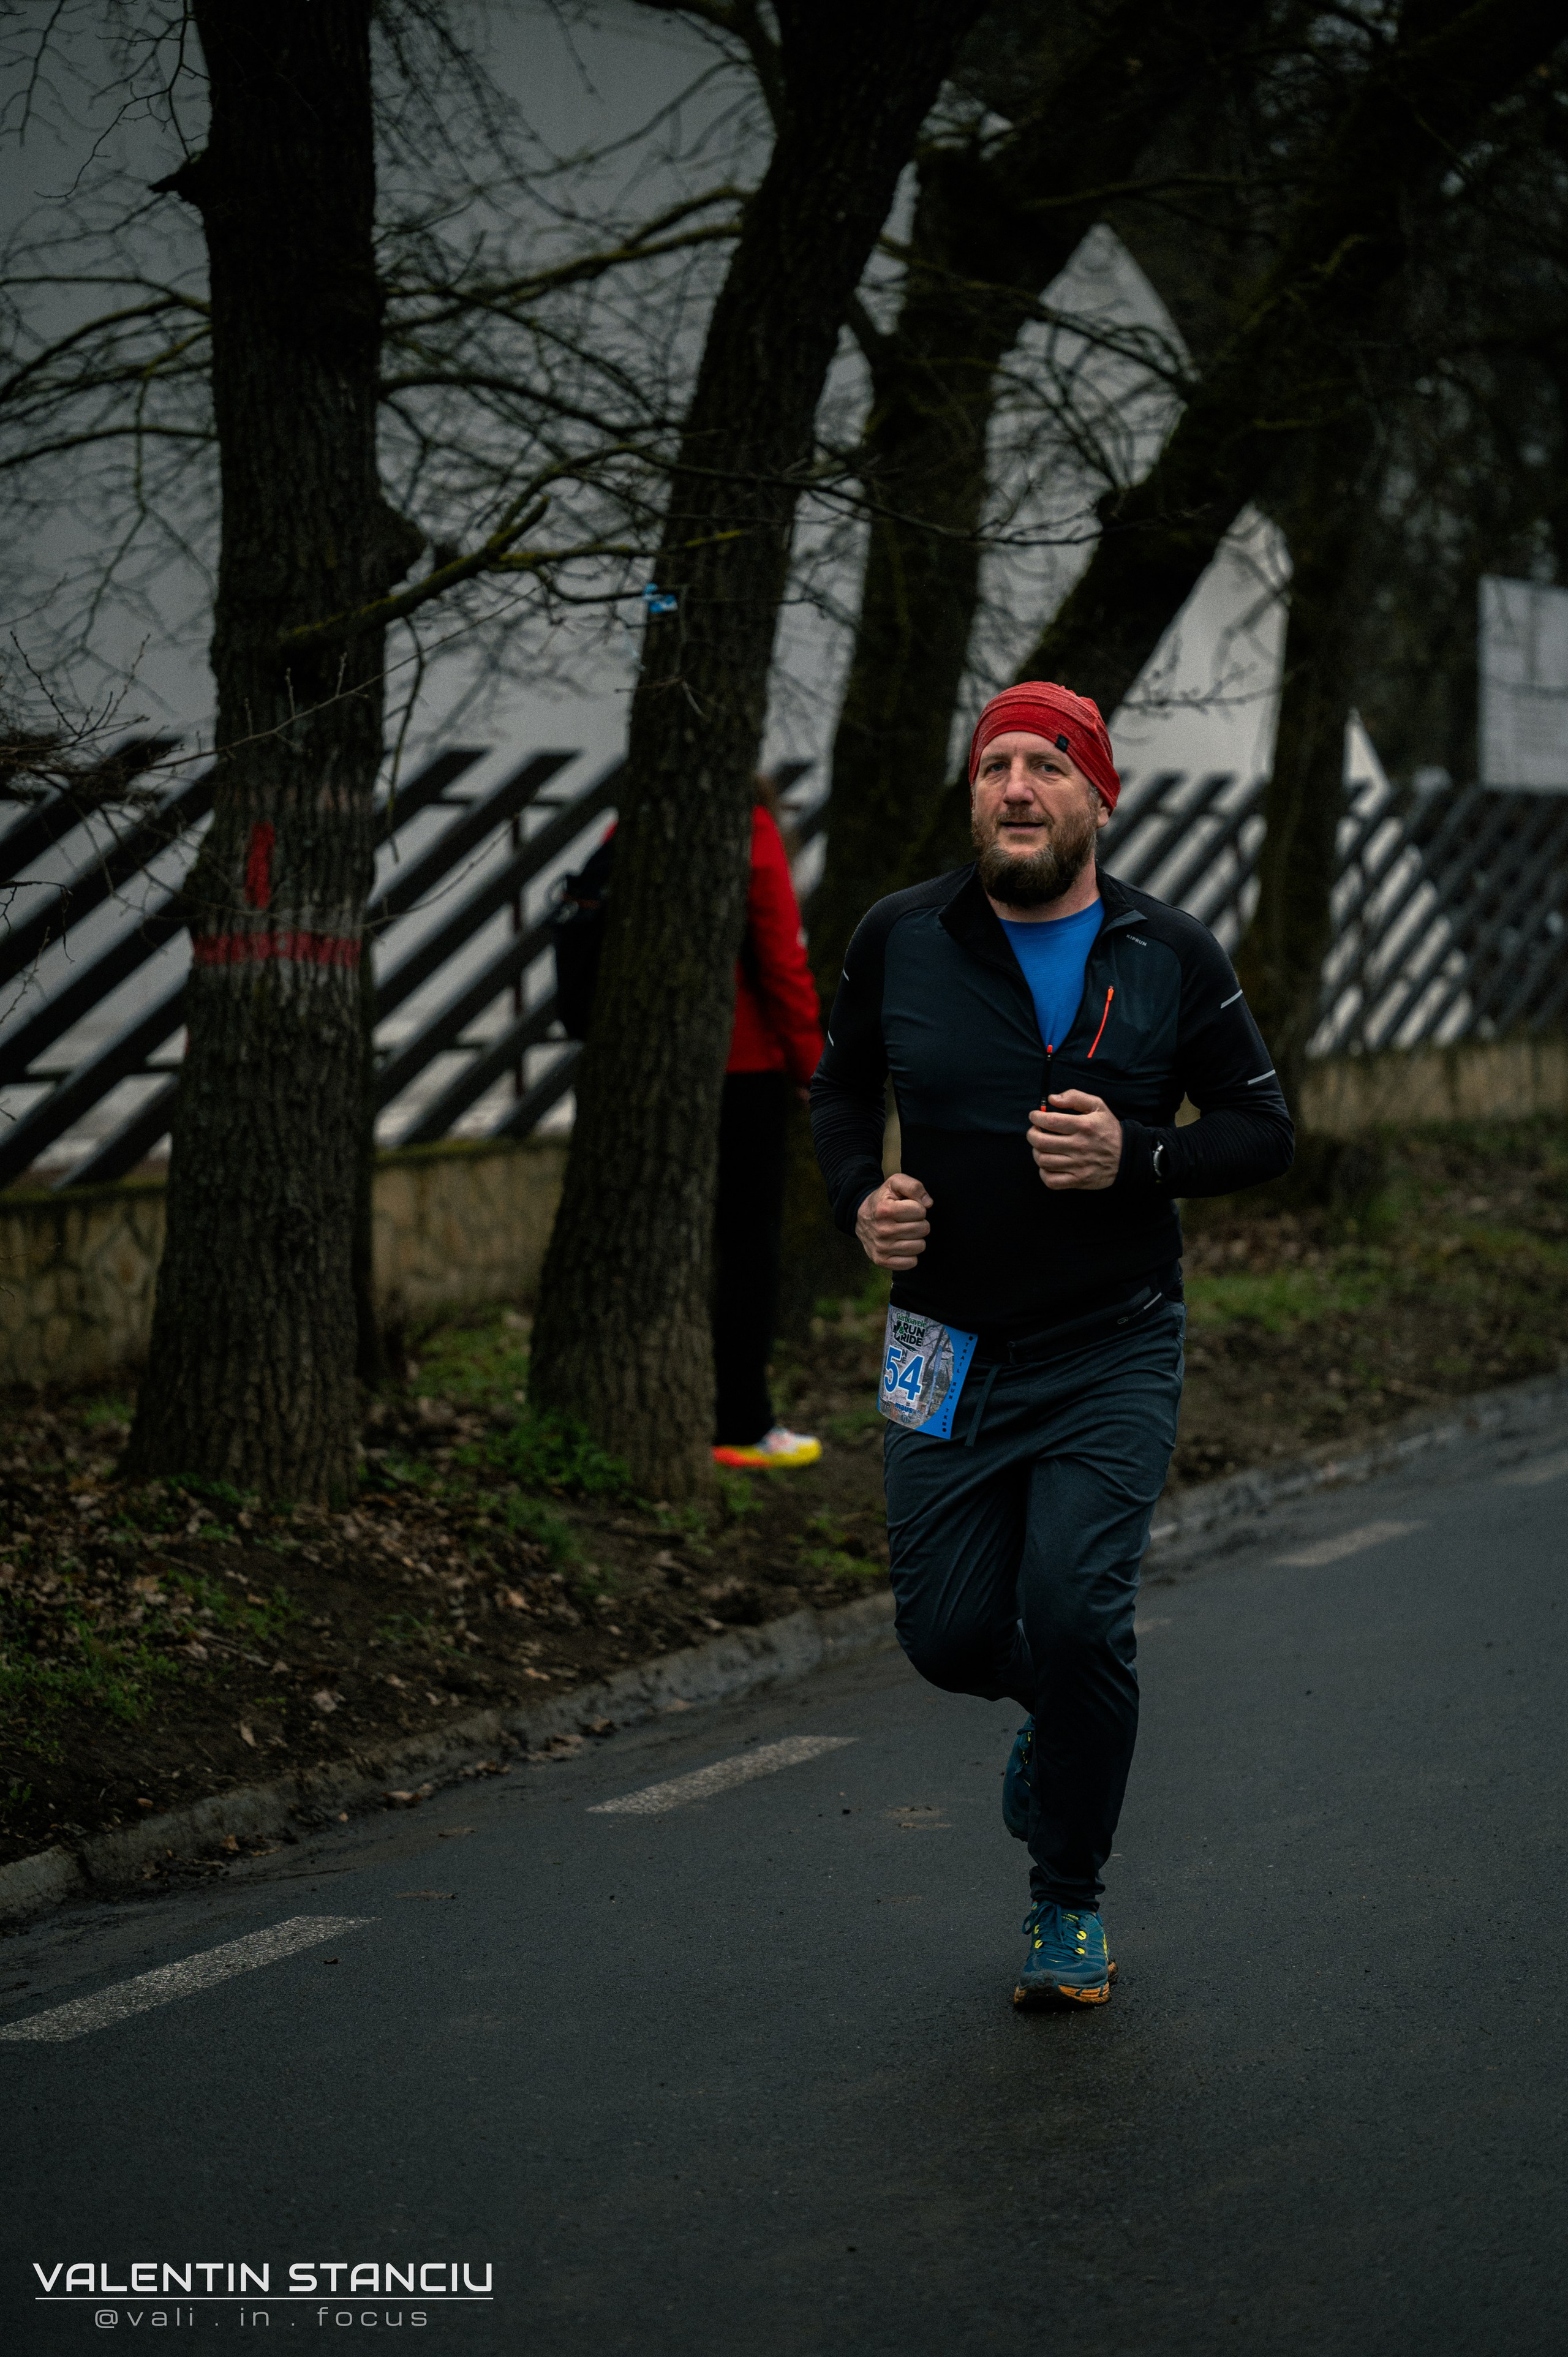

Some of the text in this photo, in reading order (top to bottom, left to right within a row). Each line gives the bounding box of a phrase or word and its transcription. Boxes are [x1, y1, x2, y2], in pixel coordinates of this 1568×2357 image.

[1126, 934, 1147, 946] KIPRUN
[903, 1322, 926, 1338] RUN
[900, 1333, 924, 1347] RIDE
[956, 1342, 970, 1373] TRAIL
[884, 1345, 925, 1401] 54
[895, 1403, 913, 1413] maus
